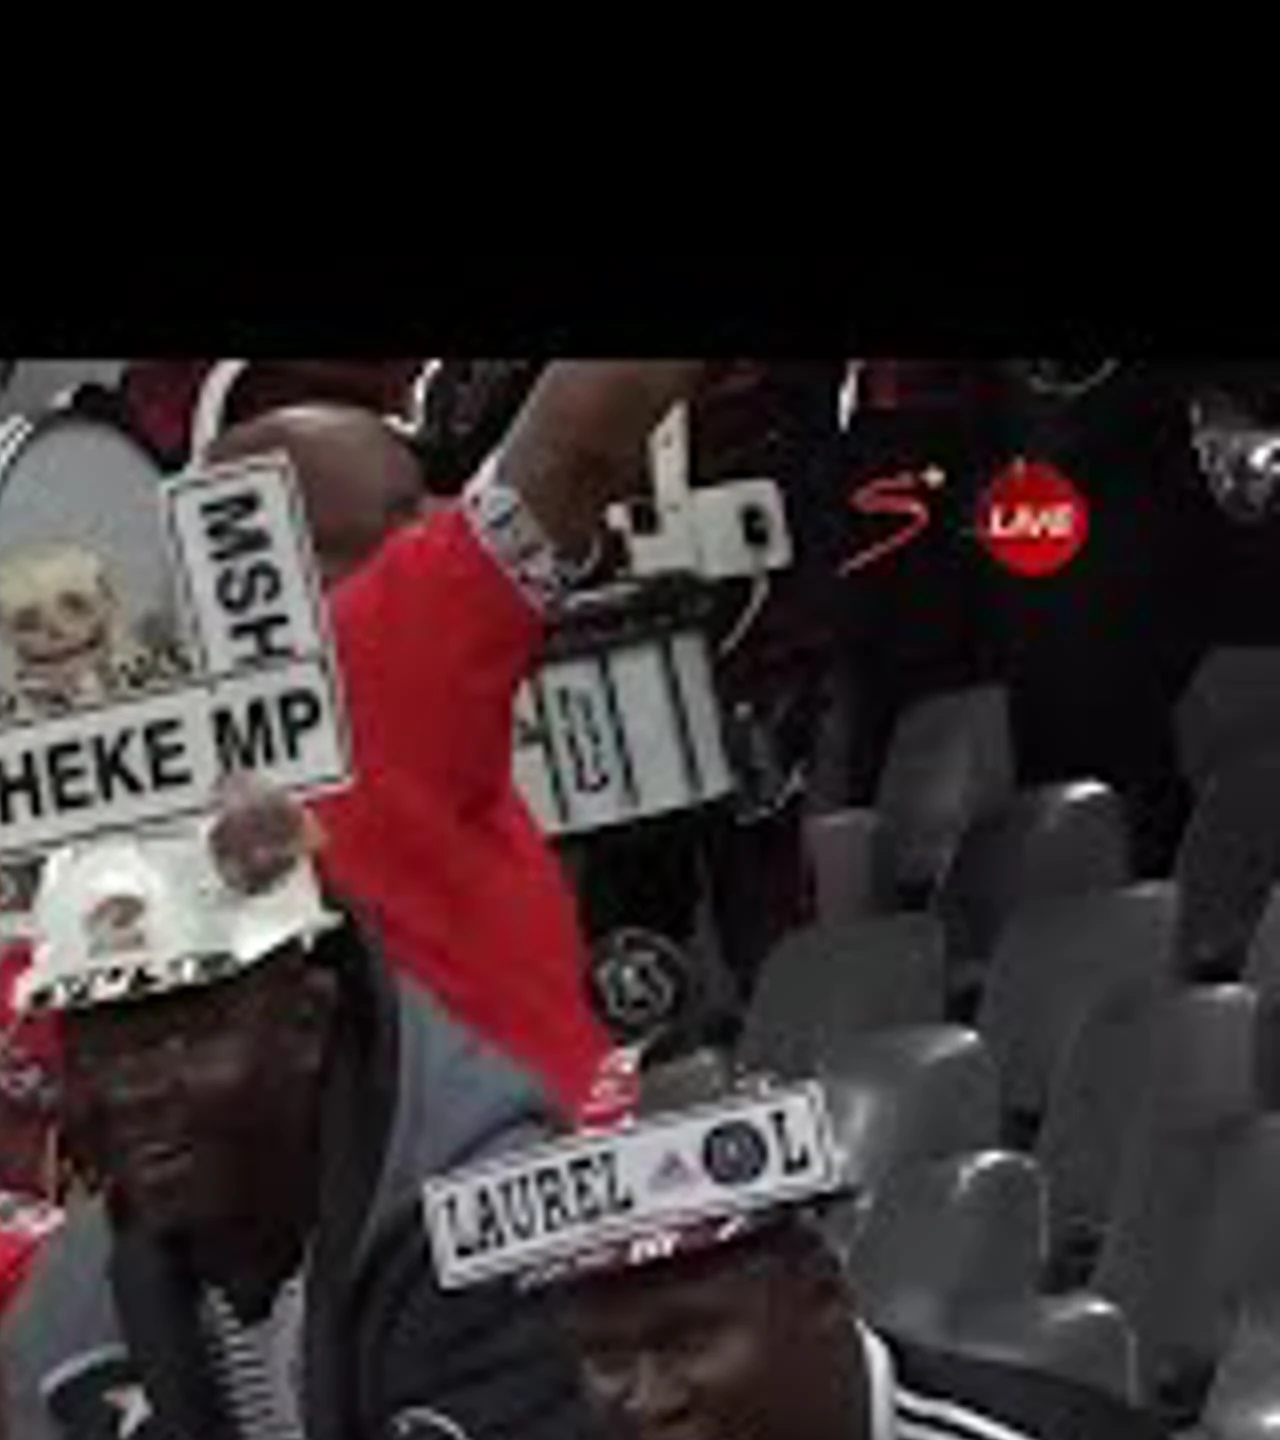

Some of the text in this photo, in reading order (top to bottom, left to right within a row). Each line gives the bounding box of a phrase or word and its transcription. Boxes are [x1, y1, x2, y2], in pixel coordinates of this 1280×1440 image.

[209, 687, 322, 777] MP
[439, 1149, 634, 1258] LAUREL
[766, 1109, 811, 1177] L
